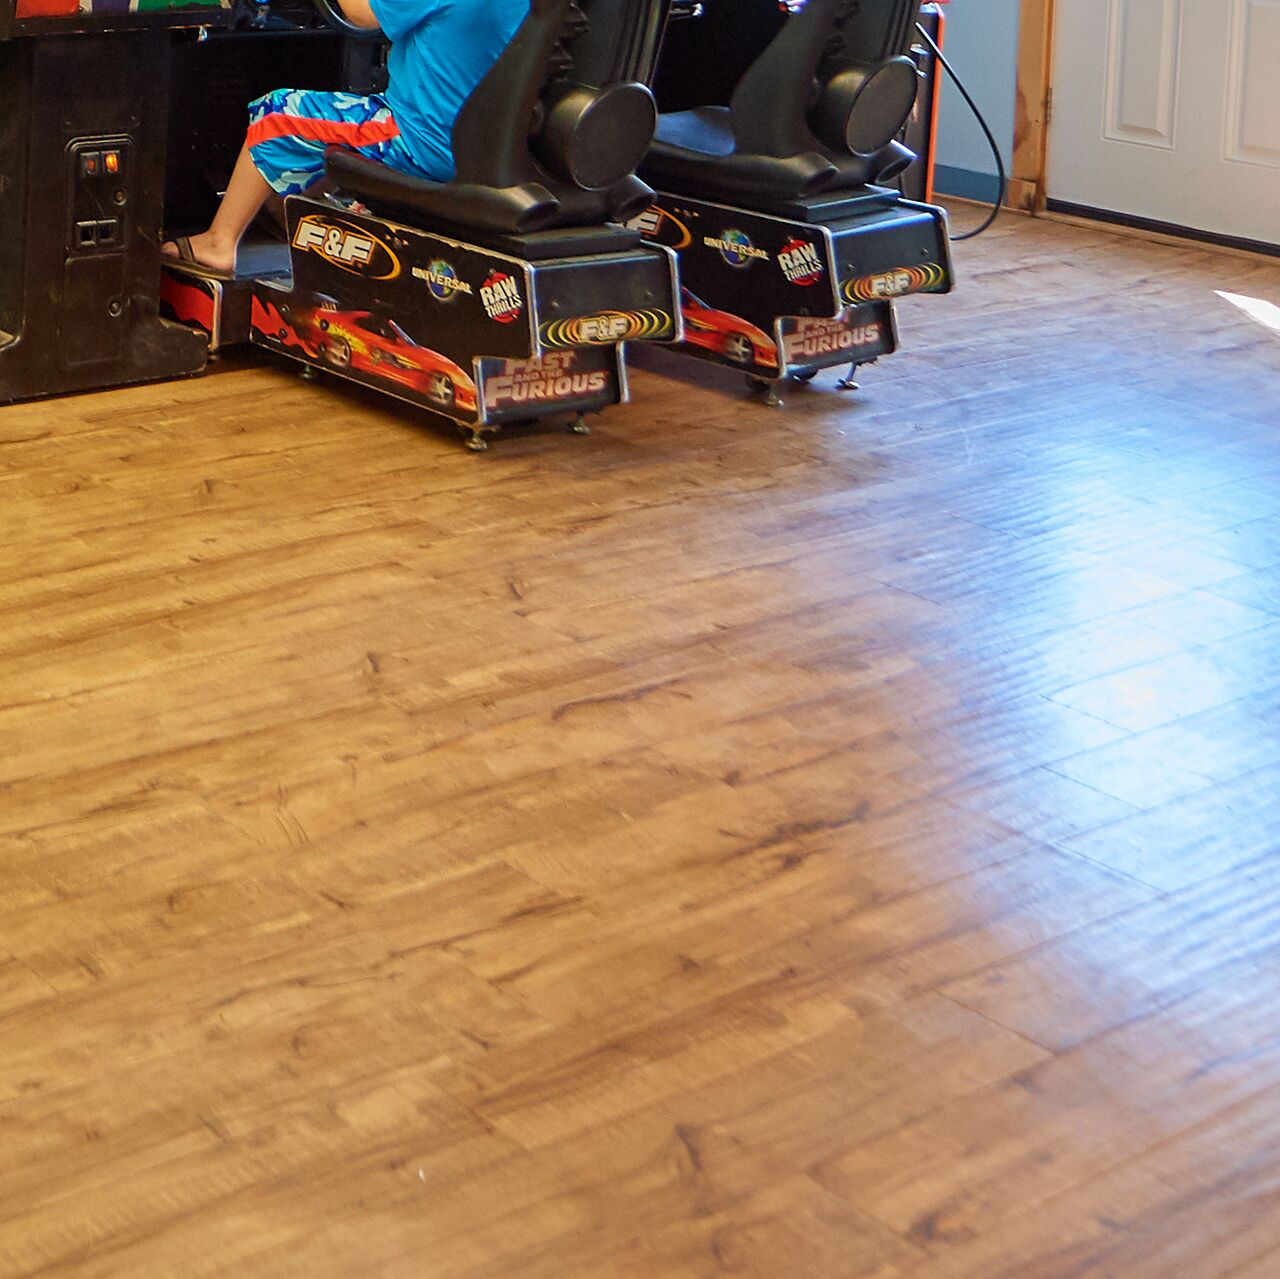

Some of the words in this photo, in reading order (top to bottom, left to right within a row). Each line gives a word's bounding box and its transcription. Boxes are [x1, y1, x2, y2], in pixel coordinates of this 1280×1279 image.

[295, 220, 374, 264] F&F
[703, 236, 771, 261] UNIVERSAL
[777, 242, 820, 270] RAW
[411, 266, 473, 295] UNIVERSAL
[783, 260, 824, 282] THRILLS
[479, 276, 519, 306] RAW
[485, 294, 523, 318] THRILLS
[580, 316, 628, 341] F&F
[783, 323, 880, 363] FURIOUS
[505, 350, 576, 375] FAST
[486, 371, 608, 408] FURIOUS
